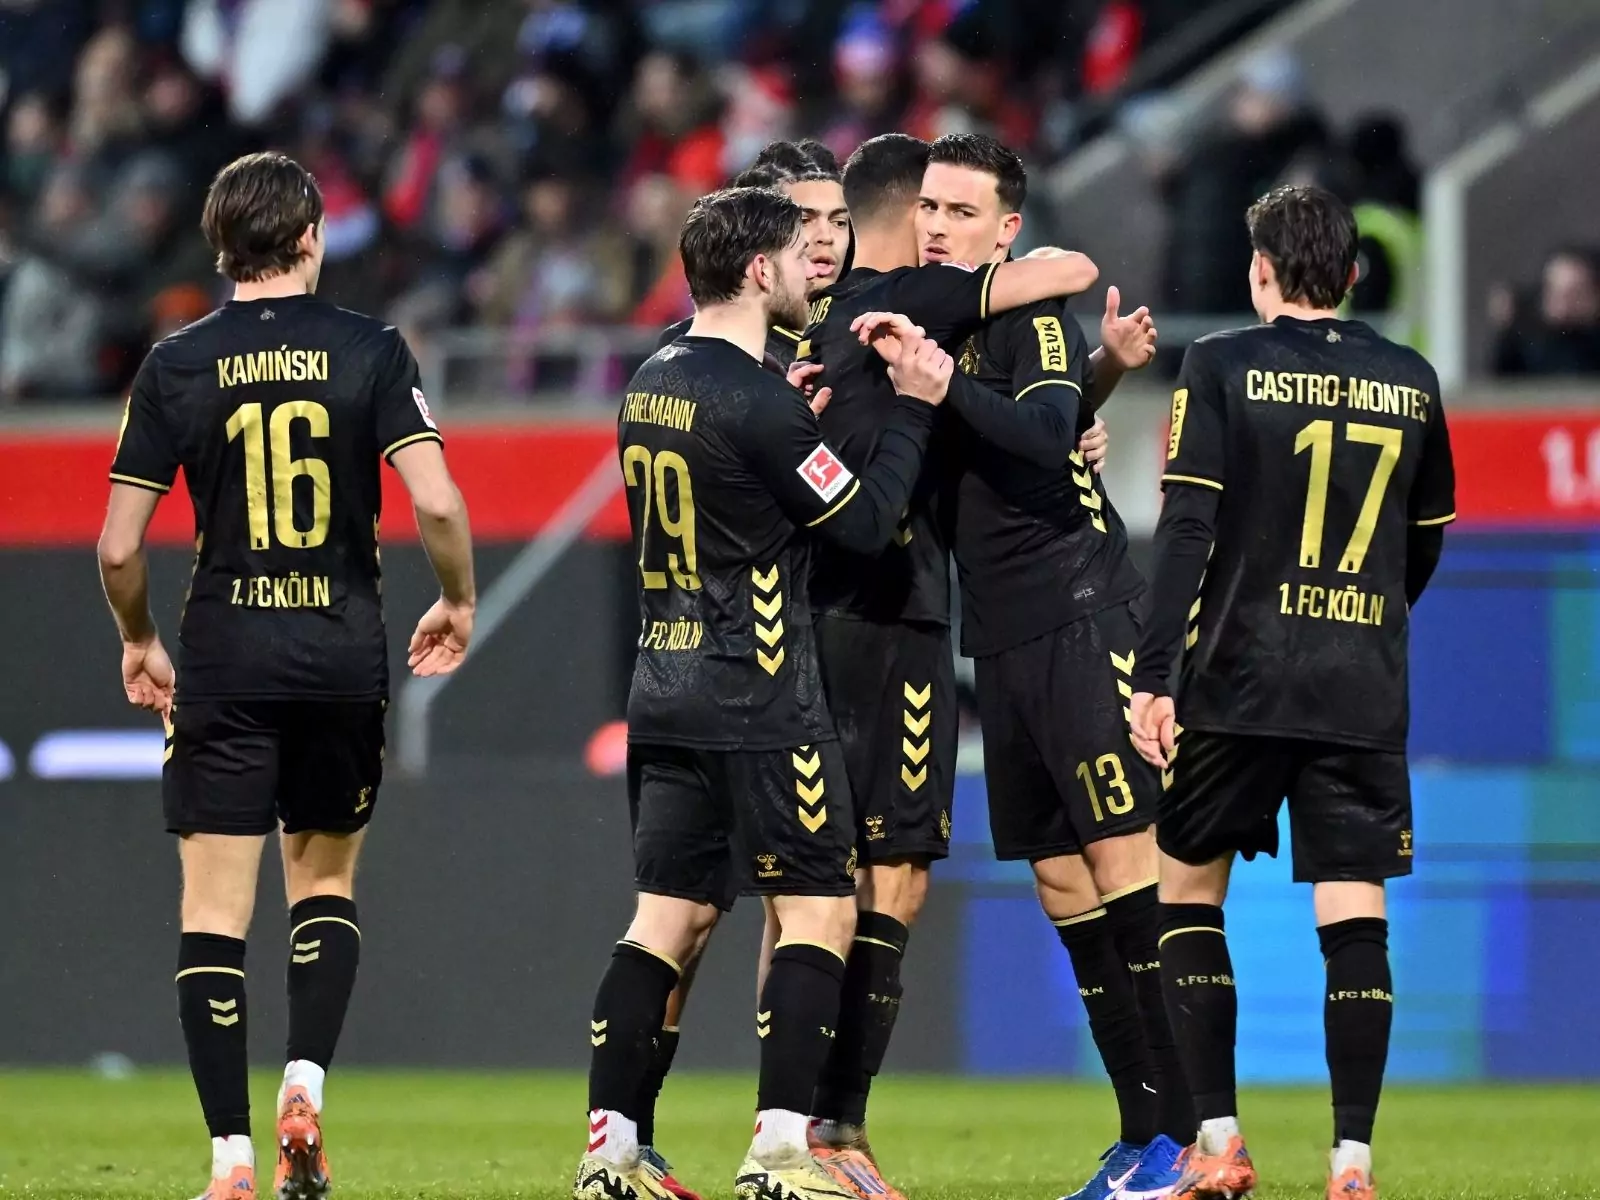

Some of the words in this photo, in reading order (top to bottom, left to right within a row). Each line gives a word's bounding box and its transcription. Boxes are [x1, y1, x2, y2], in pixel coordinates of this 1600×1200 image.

[1041, 321, 1062, 366] DEVK
[217, 345, 328, 388] KAMIŃSKI
[623, 392, 697, 432] THIELMANN
[1246, 369, 1430, 423] CASTRO-MONTES
[225, 400, 331, 550] 16
[1294, 419, 1403, 574] 17
[623, 445, 702, 591] 29
[231, 578, 243, 605] 1.
[247, 576, 273, 607] FC
[273, 571, 330, 608] KÖLN
[1279, 582, 1293, 615] 1.
[1296, 584, 1325, 618] FC
[1326, 584, 1385, 626] KÖLN
[643, 620, 668, 650] FC
[664, 615, 703, 651] KÖLN
[1076, 752, 1135, 822] 13
[1188, 975, 1209, 985] FC
[1338, 990, 1359, 1000] FC
